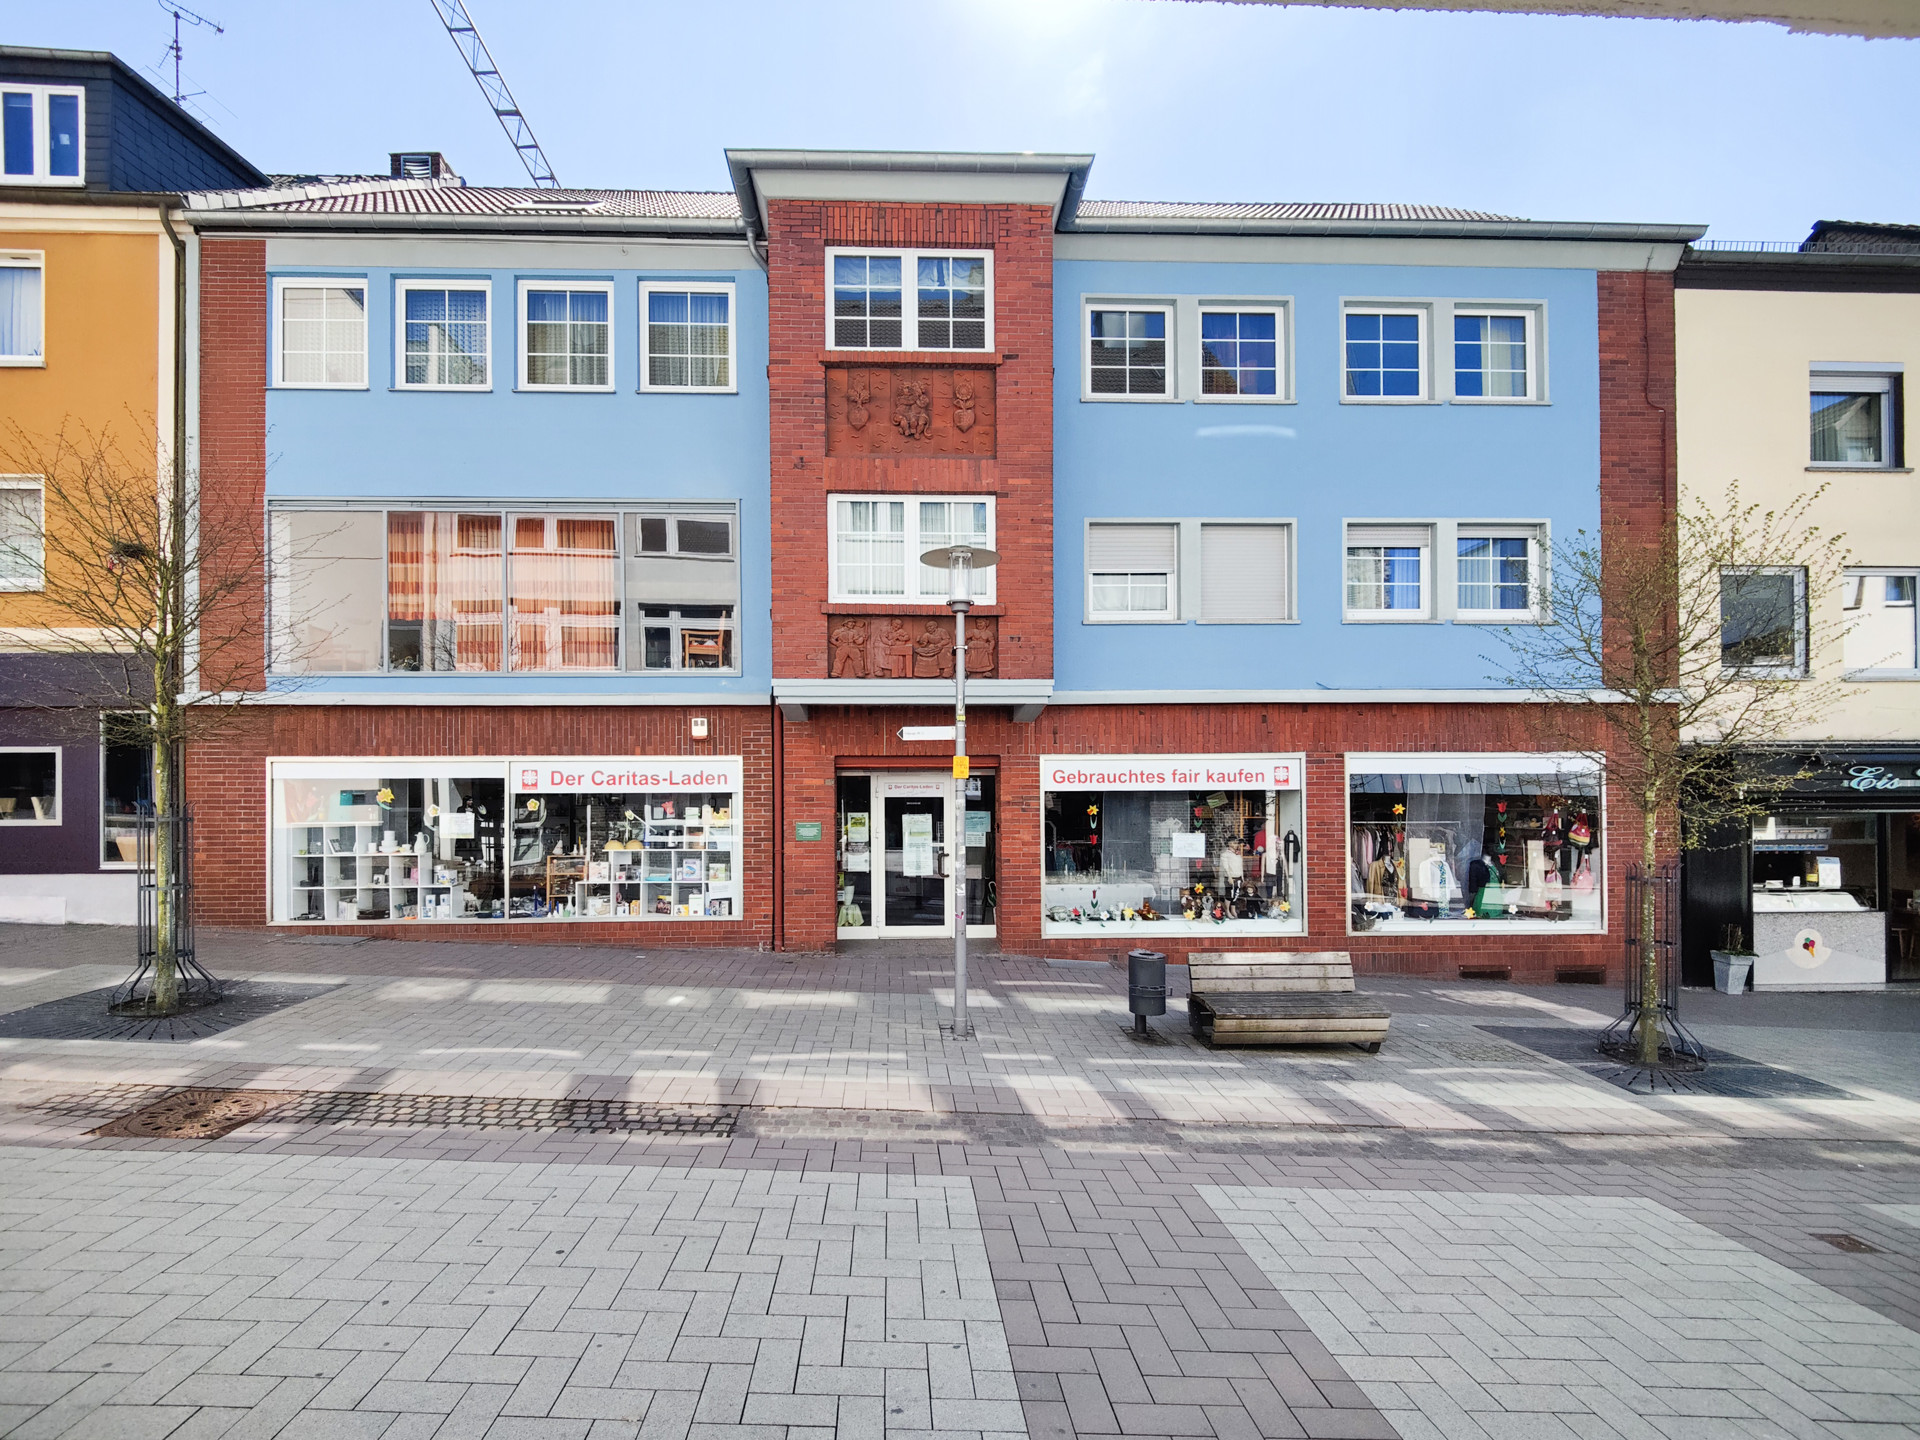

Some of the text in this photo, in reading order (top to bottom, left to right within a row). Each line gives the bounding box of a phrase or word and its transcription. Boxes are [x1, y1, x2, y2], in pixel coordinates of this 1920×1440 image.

[551, 770, 728, 786] Der Caritas-Laden
[1052, 767, 1265, 784] Gebrauchtes fair kaufen
[1848, 765, 1902, 792] Eis
